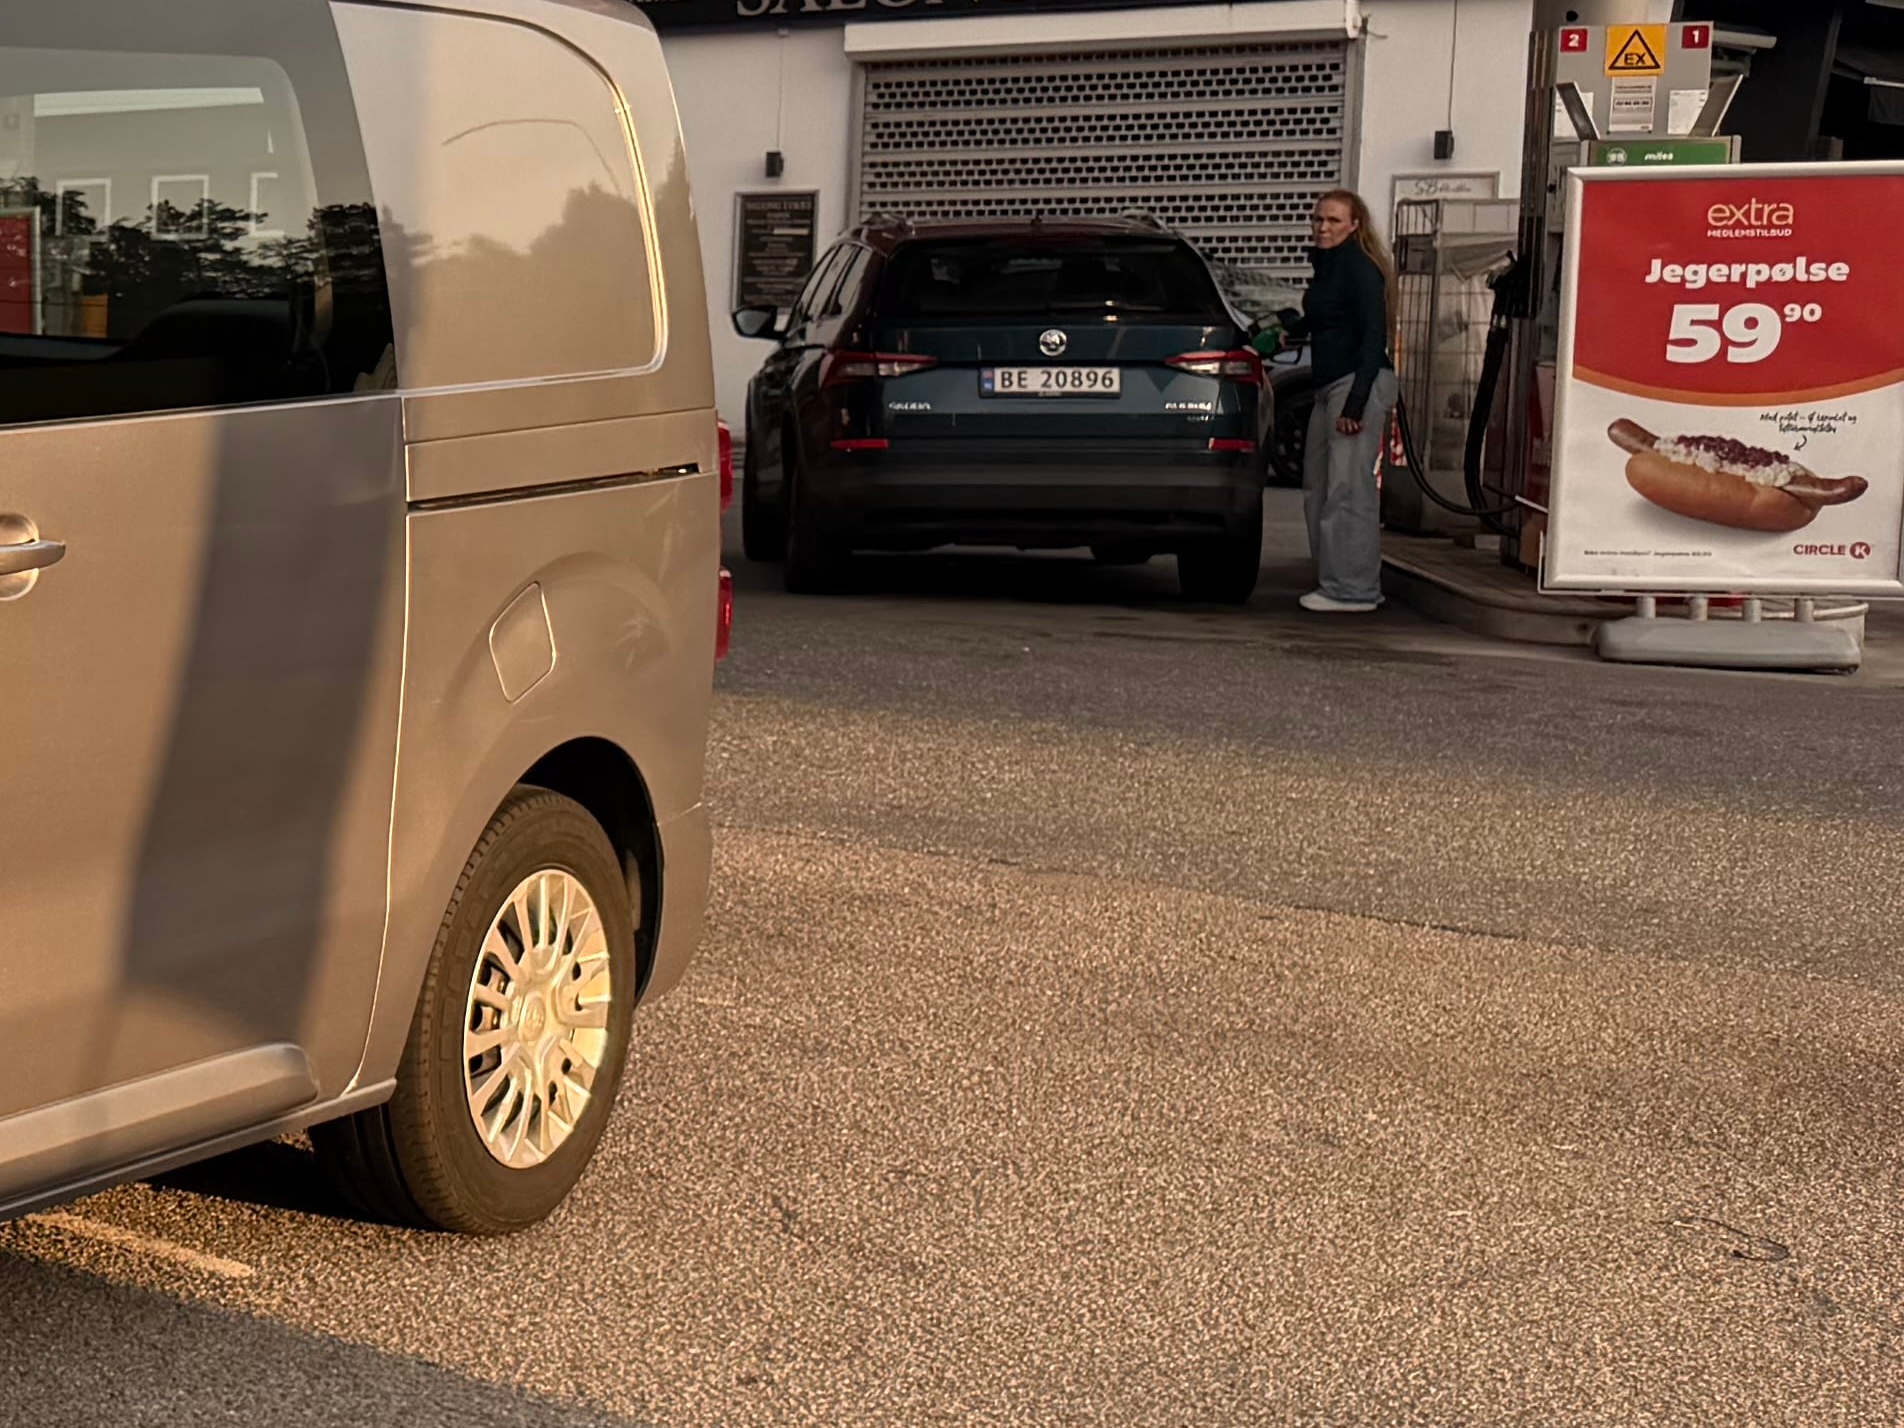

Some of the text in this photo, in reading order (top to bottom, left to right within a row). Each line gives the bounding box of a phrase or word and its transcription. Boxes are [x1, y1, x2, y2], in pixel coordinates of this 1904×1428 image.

[1568, 33, 1580, 47] 2
[1691, 29, 1700, 44] 1
[1624, 52, 1646, 66] EX
[1707, 197, 1794, 226] extra
[1645, 256, 1851, 289] Jegerpølse
[1665, 302, 1823, 364] 59 90
[1000, 369, 1114, 389] BE 20896
[1793, 544, 1846, 556] CIRCLE
